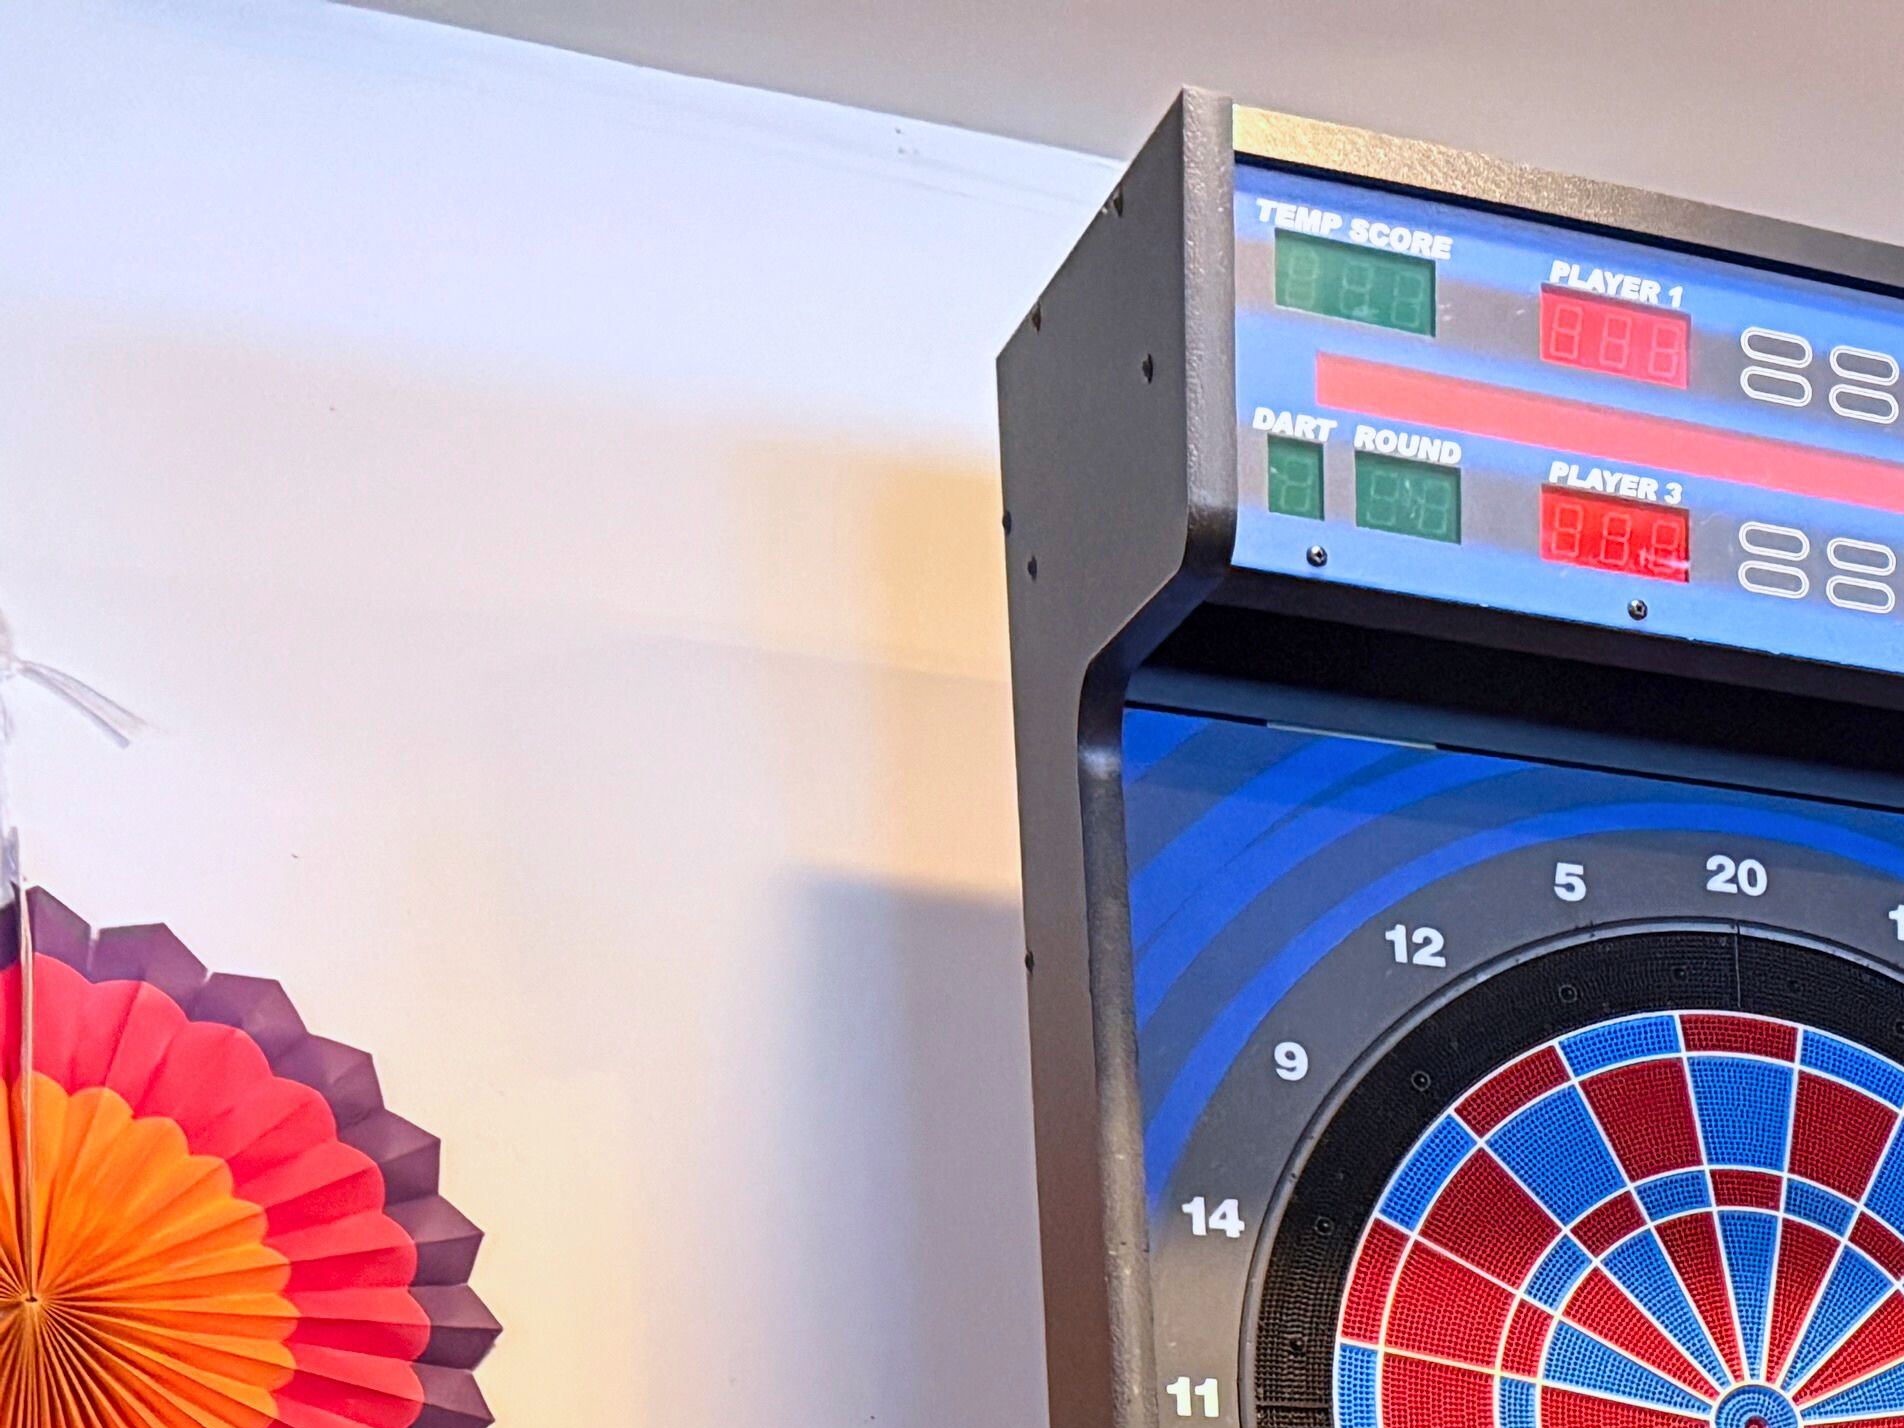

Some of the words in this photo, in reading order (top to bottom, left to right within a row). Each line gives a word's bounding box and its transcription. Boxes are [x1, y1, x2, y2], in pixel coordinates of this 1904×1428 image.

[1257, 199, 1342, 232] TEMP
[1349, 217, 1454, 260] SCORE
[1549, 259, 1662, 305] PLAYER
[1668, 284, 1683, 309] 1
[1252, 407, 1337, 443] DART
[1354, 423, 1462, 464] ROUND
[1548, 460, 1660, 503] PLAYER
[1663, 480, 1682, 505] 3
[1554, 863, 1586, 902] 5
[1705, 856, 1769, 897] 20
[1385, 925, 1447, 969] 12
[1274, 1043, 1309, 1081] 9
[1182, 1197, 1245, 1238] 14
[1166, 1376, 1219, 1418] 11
